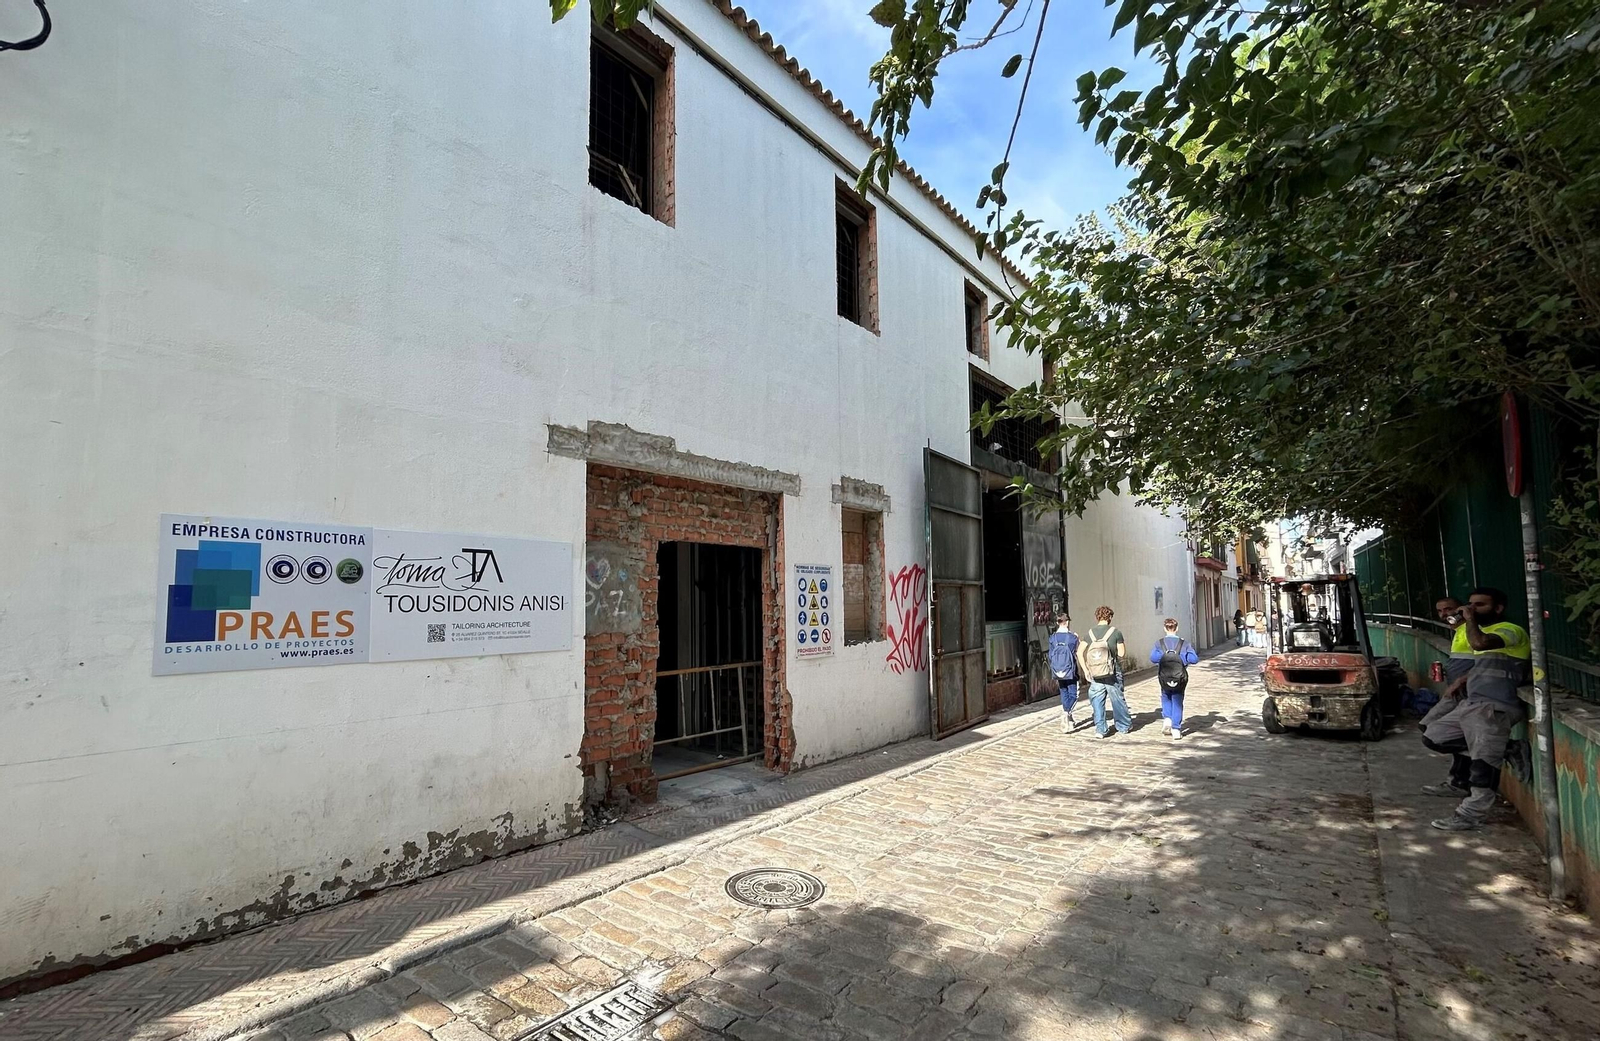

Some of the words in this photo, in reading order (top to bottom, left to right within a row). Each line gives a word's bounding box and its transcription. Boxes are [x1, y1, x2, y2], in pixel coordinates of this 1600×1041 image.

[172, 523, 250, 539] EMPRESA
[255, 528, 366, 546] CONSTRUCTORA
[384, 594, 514, 613] TOUSIDONIS
[519, 595, 564, 611] ANISI
[217, 610, 355, 641] PRAES
[452, 622, 485, 630] TAILORING
[165, 643, 259, 654] DESARROLLO
[265, 642, 280, 650] DE
[286, 638, 355, 648] PROYECTOS
[280, 648, 354, 659] www.praes.es
[1287, 655, 1339, 665] TOYOTA
